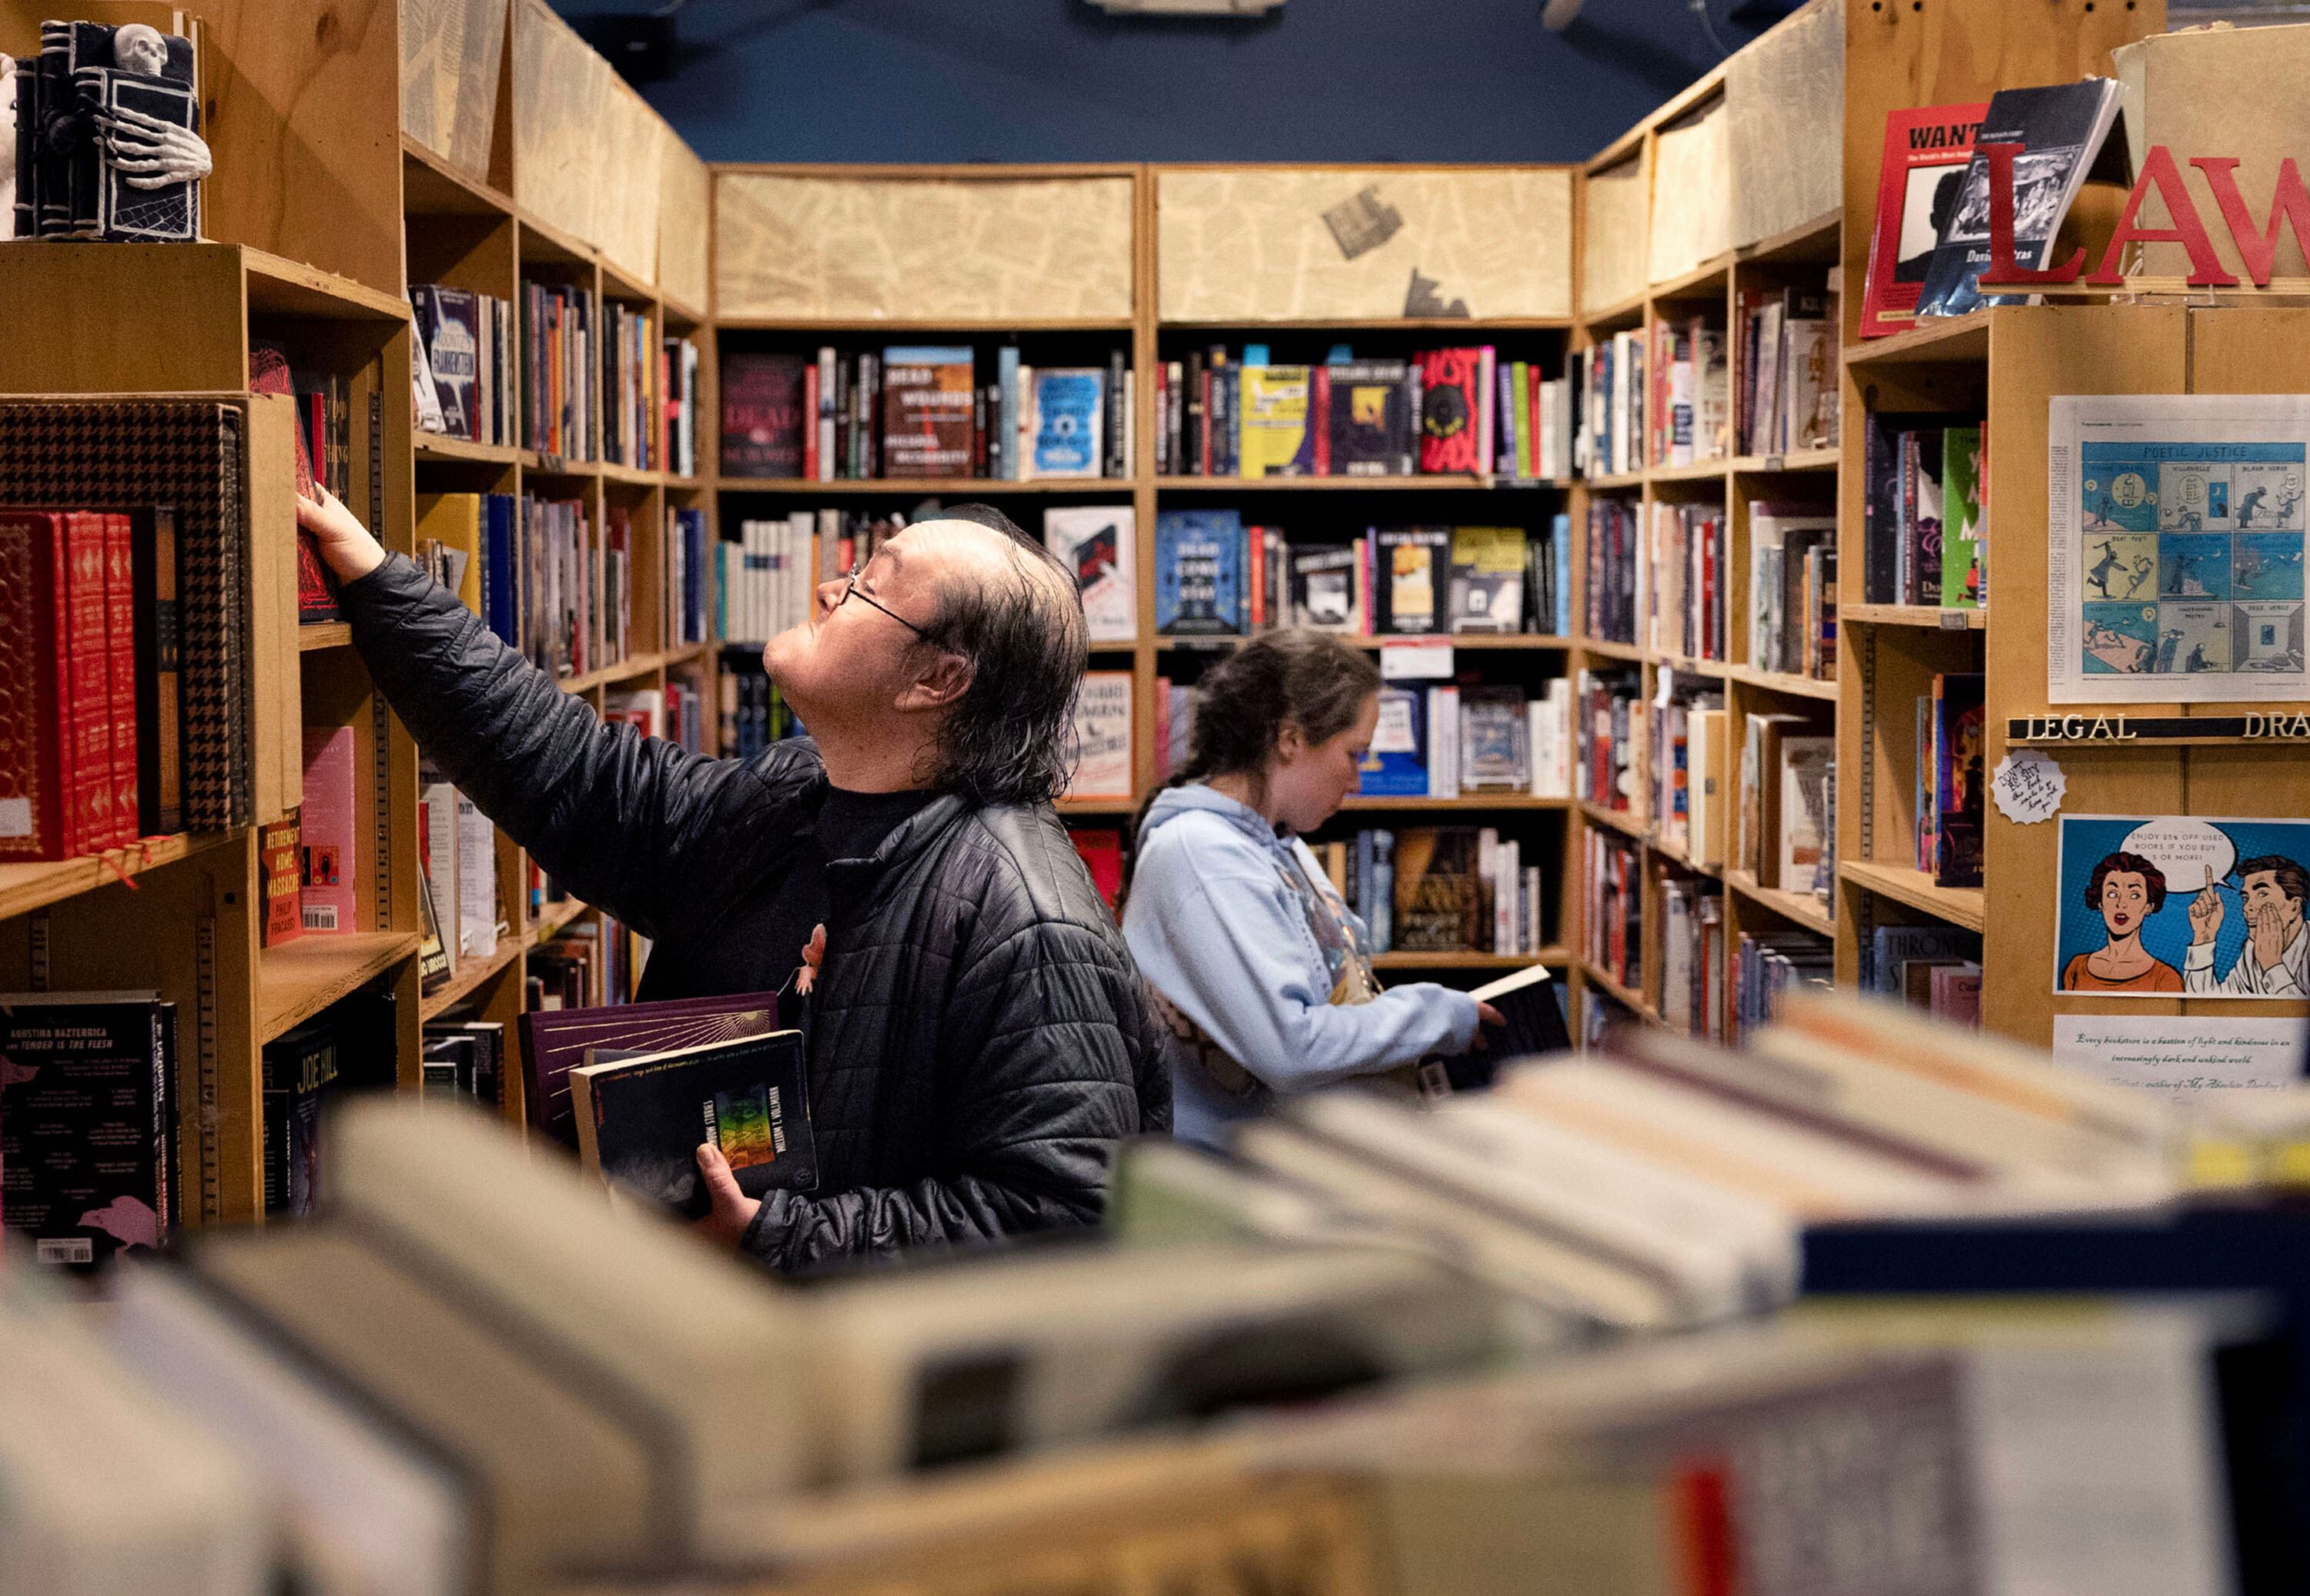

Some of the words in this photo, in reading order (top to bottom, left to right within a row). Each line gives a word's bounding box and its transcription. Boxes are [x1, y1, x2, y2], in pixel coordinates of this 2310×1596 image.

[1977, 142, 2310, 287] LAW
[434, 350, 474, 376] FRANKENSTEIN
[2144, 446, 2188, 457] POETIC
[2197, 446, 2248, 457] JUSTICE
[2026, 713, 2138, 741] LEGAL
[1998, 761, 2025, 788] DON'T
[2020, 762, 2040, 782] SHY
[276, 851, 294, 872] HOME
[266, 872, 300, 899] MASSACRE
[276, 901, 293, 918] PHILIP
[11, 1029, 52, 1039] AGUSTINA
[55, 1028, 108, 1039] BAZTERRICA
[2075, 1032, 2102, 1048] Every
[2104, 1036, 2141, 1045] bookstore
[2157, 1036, 2186, 1045] bastion
[2188, 1036, 2198, 1048] of
[2198, 1037, 2217, 1048] light
[2218, 1037, 2233, 1046] and
[2234, 1036, 2269, 1046] kindness
[21, 1040, 53, 1050] TENDER
[56, 1040, 66, 1049] IS
[69, 1039, 85, 1049] THE
[88, 1039, 114, 1049] FLESH
[2111, 1055, 2161, 1066] increasingly
[2161, 1054, 2182, 1063] dark
[2181, 1055, 2198, 1063] and
[2198, 1055, 2228, 1064] unkind
[296, 1052, 320, 1095] JOE
[2144, 1079, 2171, 1089] author
[2173, 1079, 2185, 1092] of
[772, 1126, 787, 1154] WILLIAM
